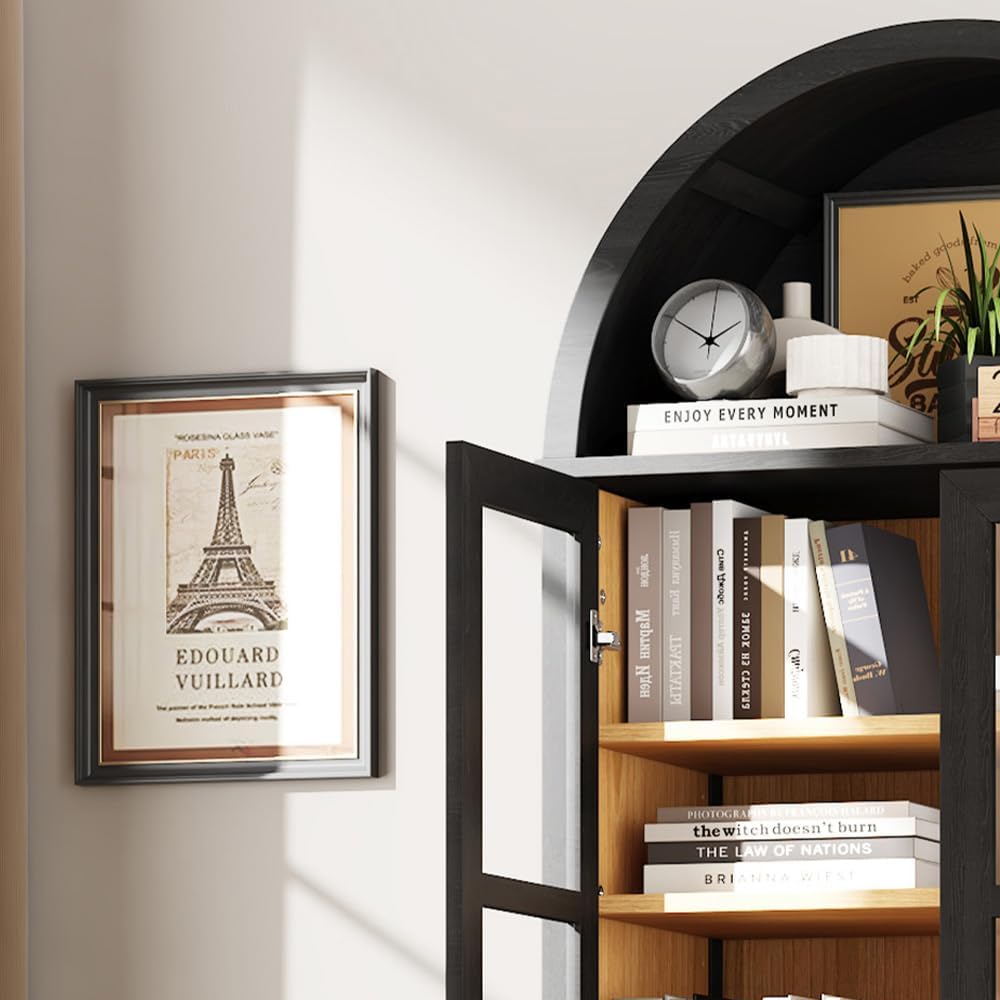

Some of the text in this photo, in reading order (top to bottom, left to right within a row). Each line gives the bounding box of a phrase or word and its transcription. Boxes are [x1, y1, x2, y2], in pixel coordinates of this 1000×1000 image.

[903, 253, 932, 284] baked
[664, 404, 838, 424] ENJOY EVERY MOMENT
[176, 647, 279, 665] EDOUARD
[175, 671, 283, 690] VUILLARD
[693, 825, 720, 838] the
[722, 823, 769, 837] witch
[838, 821, 877, 833] burn
[696, 843, 872, 858] THE LAW OF NATIONS
[704, 873, 791, 885] BRIANNA
